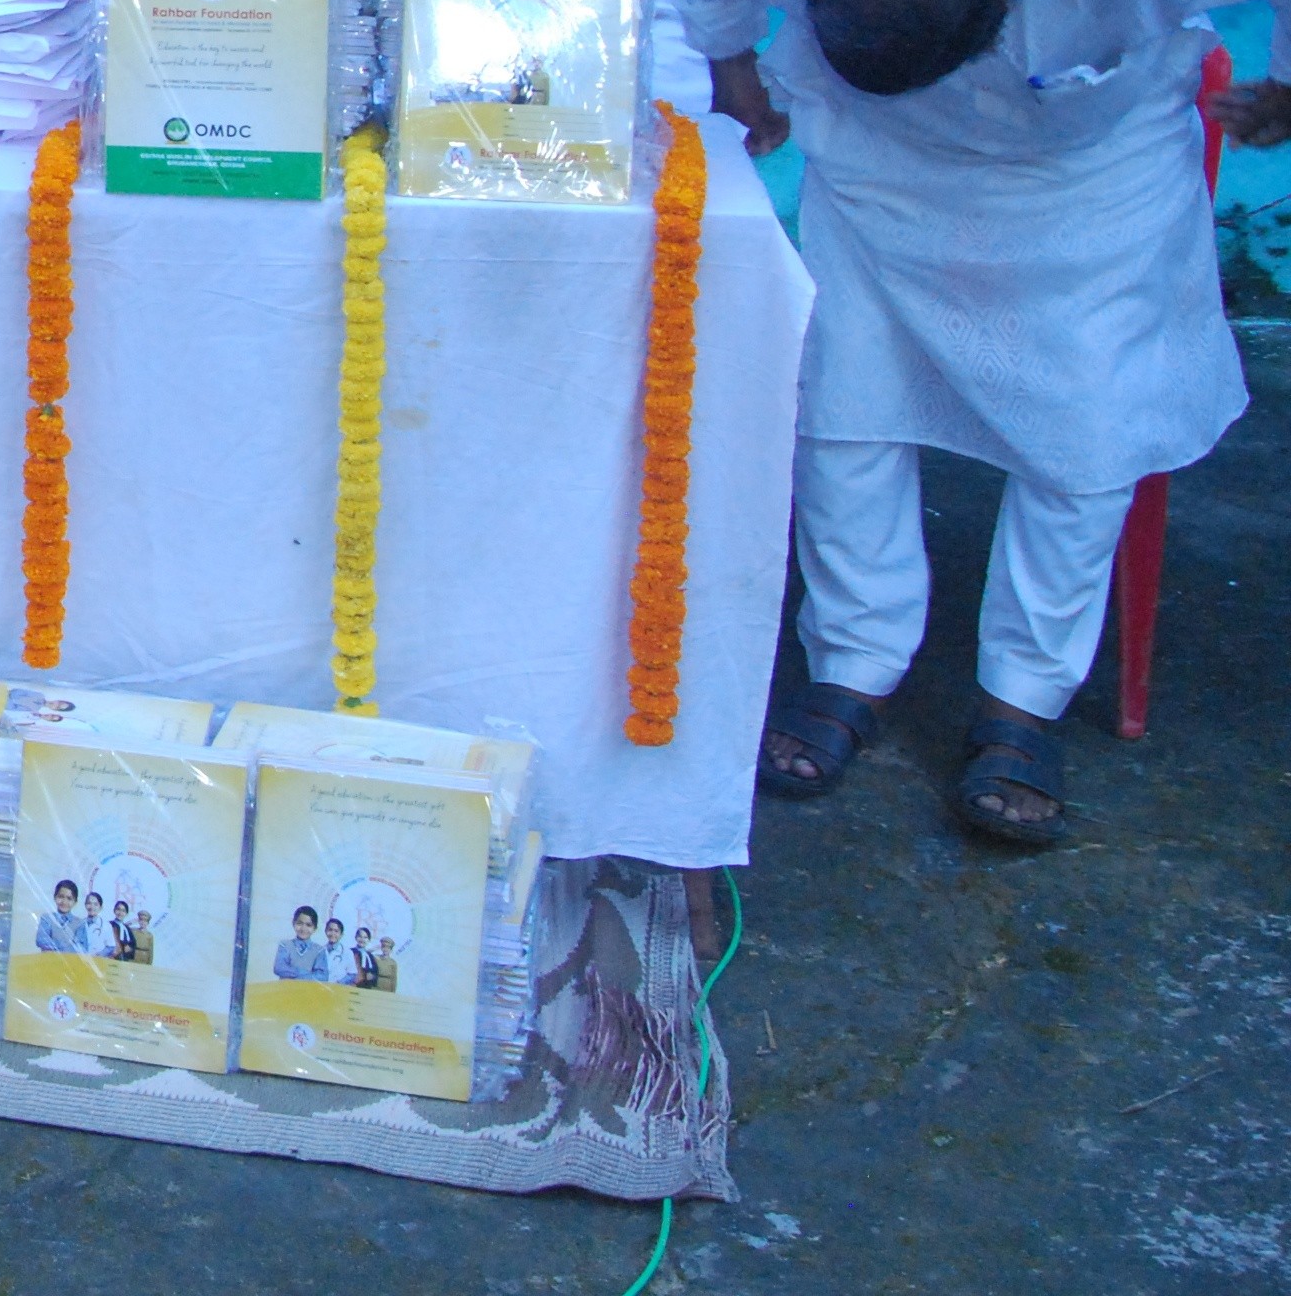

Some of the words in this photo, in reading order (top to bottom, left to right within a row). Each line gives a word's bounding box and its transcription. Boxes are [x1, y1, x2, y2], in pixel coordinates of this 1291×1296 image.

[152, 7, 197, 18] Rahbar
[201, 8, 272, 20] Foundation
[195, 123, 252, 138] OMDC
[323, 1029, 366, 1045] Rahbar
[368, 1035, 436, 1055] Foundation
